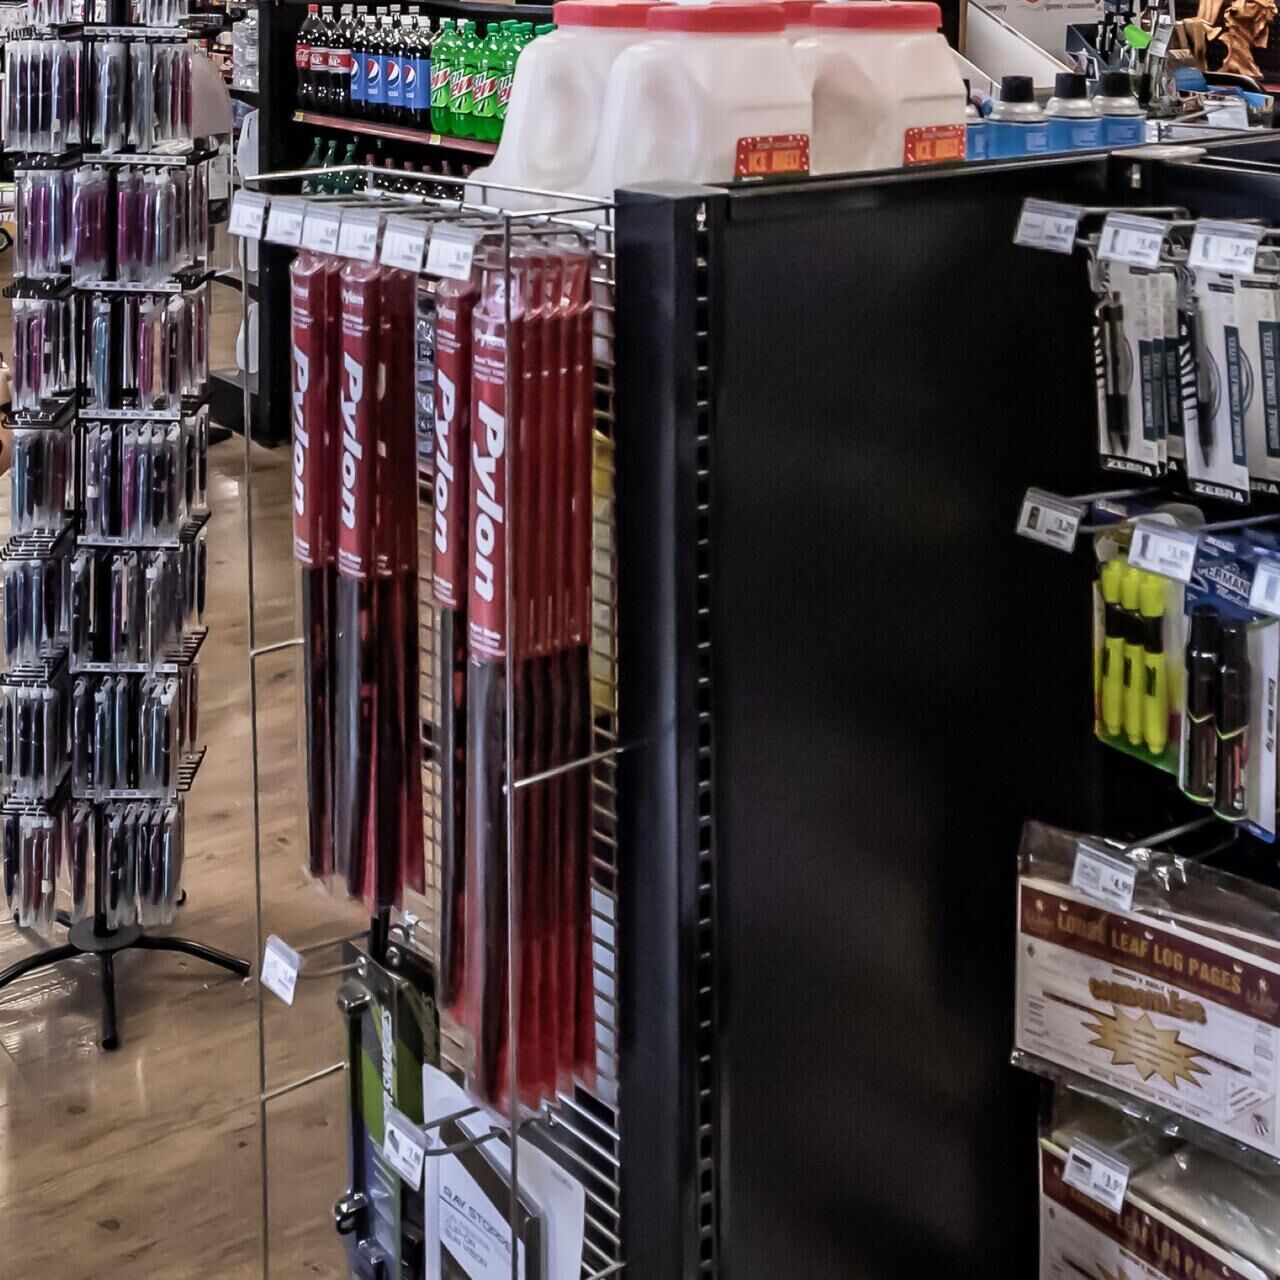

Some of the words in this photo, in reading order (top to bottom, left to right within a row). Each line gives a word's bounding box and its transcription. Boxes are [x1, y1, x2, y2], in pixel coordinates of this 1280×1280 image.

[1227, 336, 1239, 364] STEEL
[1262, 331, 1274, 358] STEEL
[1264, 359, 1277, 406] STAINLESS
[291, 352, 310, 518] Pylon
[340, 351, 364, 530] Pylon
[433, 367, 457, 555] Pylon
[1106, 460, 1153, 477] ZEBRA
[1194, 481, 1245, 503] ZEBRA
[474, 399, 506, 603] Pylon
[1111, 928, 1150, 958] LEAF
[1153, 943, 1184, 972] LOG
[1187, 956, 1243, 996] PAGES
